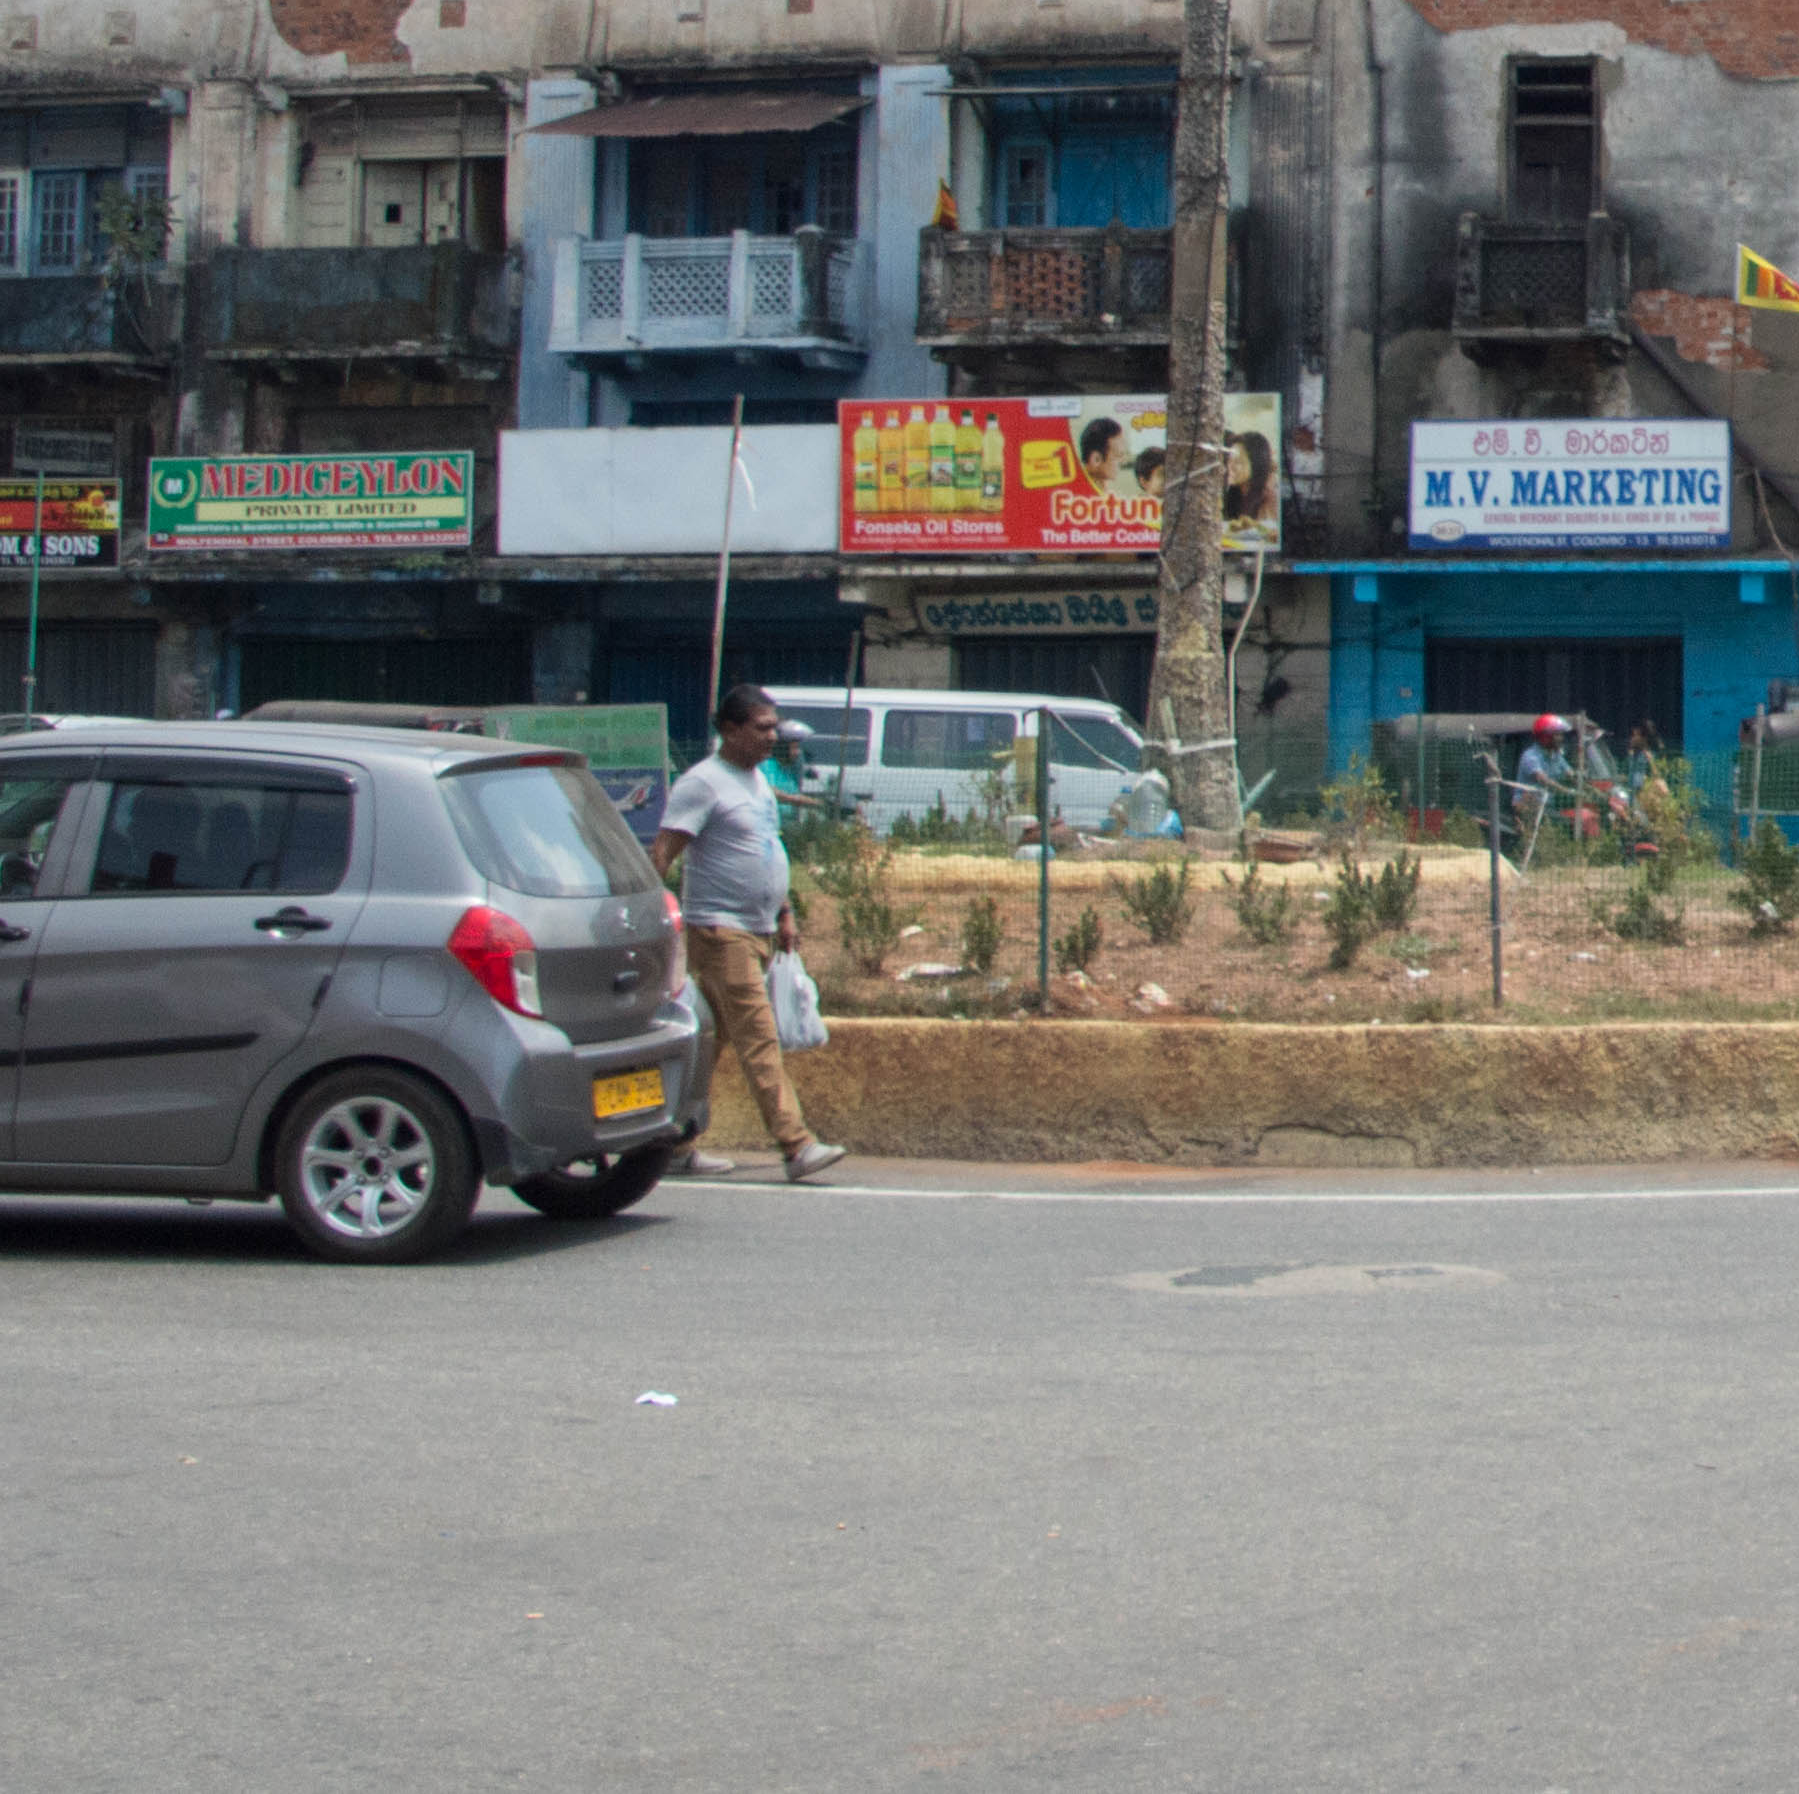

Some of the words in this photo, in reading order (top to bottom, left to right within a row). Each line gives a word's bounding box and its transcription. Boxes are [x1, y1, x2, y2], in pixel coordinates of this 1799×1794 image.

[1510, 468, 1722, 507] MARKETING
[246, 503, 328, 517] PRIVATE
[336, 502, 418, 516] LIMITED
[1051, 489, 1164, 525] Fortun
[855, 520, 922, 535] Fonseka
[925, 519, 948, 534] Oil
[953, 519, 1004, 535] Stores
[24, 536, 36, 556] &
[44, 535, 102, 556] SONS
[1041, 529, 1067, 544] The
[1069, 529, 1112, 544] Better
